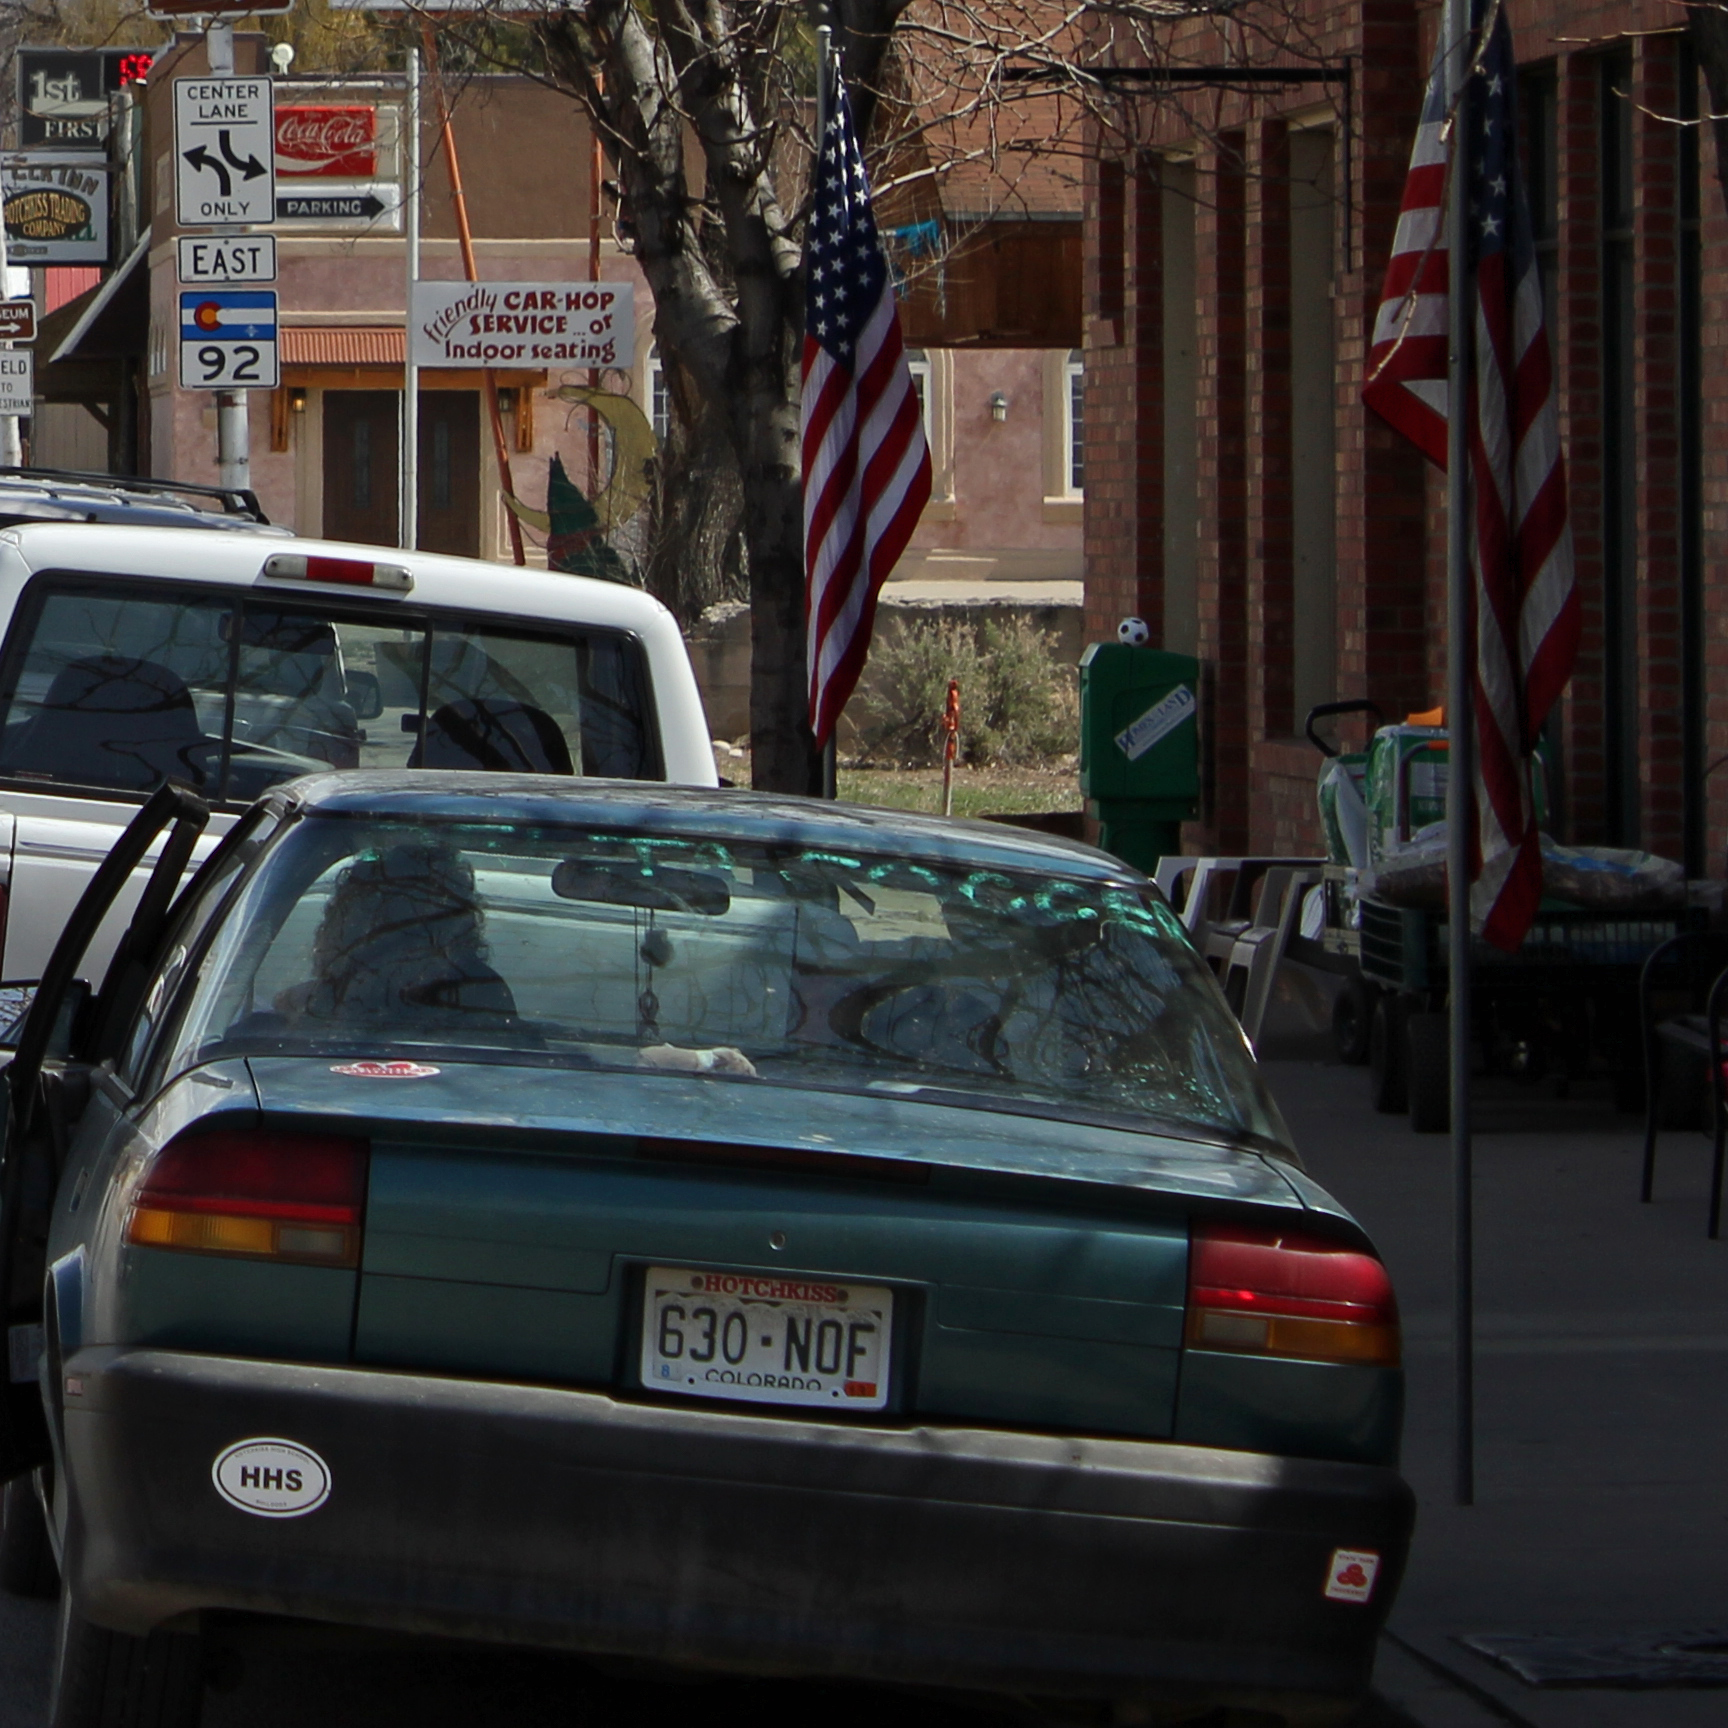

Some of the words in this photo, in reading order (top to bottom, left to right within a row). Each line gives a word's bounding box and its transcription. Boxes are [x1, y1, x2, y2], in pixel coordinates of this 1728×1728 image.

[31, 70, 80, 103] 1st
[187, 85, 259, 100] CENTER
[199, 104, 248, 119] LANE
[277, 116, 365, 150] Coca-Cola
[49, 193, 85, 223] TRADING
[200, 201, 251, 217] ONLY
[287, 199, 362, 214] PARKING
[23, 222, 66, 237] COMPANY
[192, 244, 261, 274] EAST
[423, 288, 497, 344] friendly
[504, 291, 614, 312] CAR-HOP
[469, 314, 567, 335] SERVICE
[198, 345, 260, 381] 92
[445, 339, 526, 359] Indoor
[531, 336, 616, 364] seating
[1, 382, 13, 393] TO
[703, 1274, 838, 1303] HOTCHKISS
[705, 1368, 822, 1391] COLORADO
[241, 1465, 303, 1492] HHS
